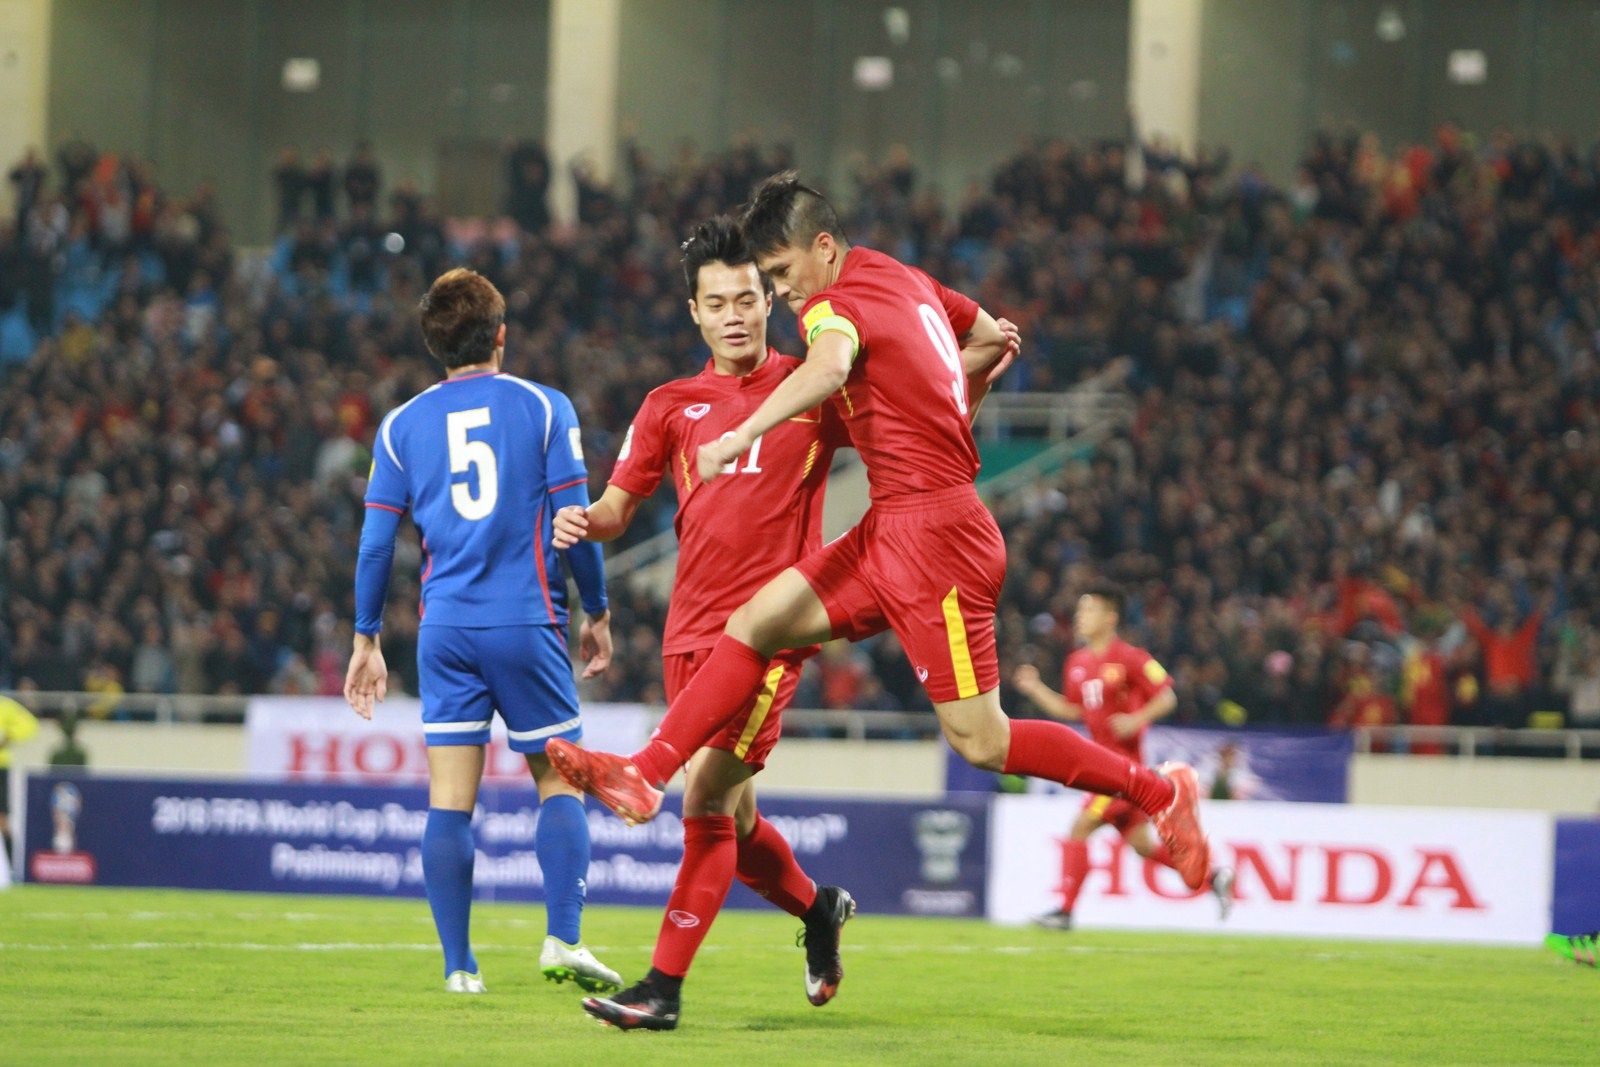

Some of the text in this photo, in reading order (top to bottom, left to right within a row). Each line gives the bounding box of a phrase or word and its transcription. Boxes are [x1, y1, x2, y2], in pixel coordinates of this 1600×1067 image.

[918, 304, 967, 415] 9
[447, 406, 498, 521] 5
[212, 797, 261, 836] FIFA
[264, 799, 332, 839] World
[334, 801, 382, 845] Cup
[271, 842, 400, 889] Preliminary
